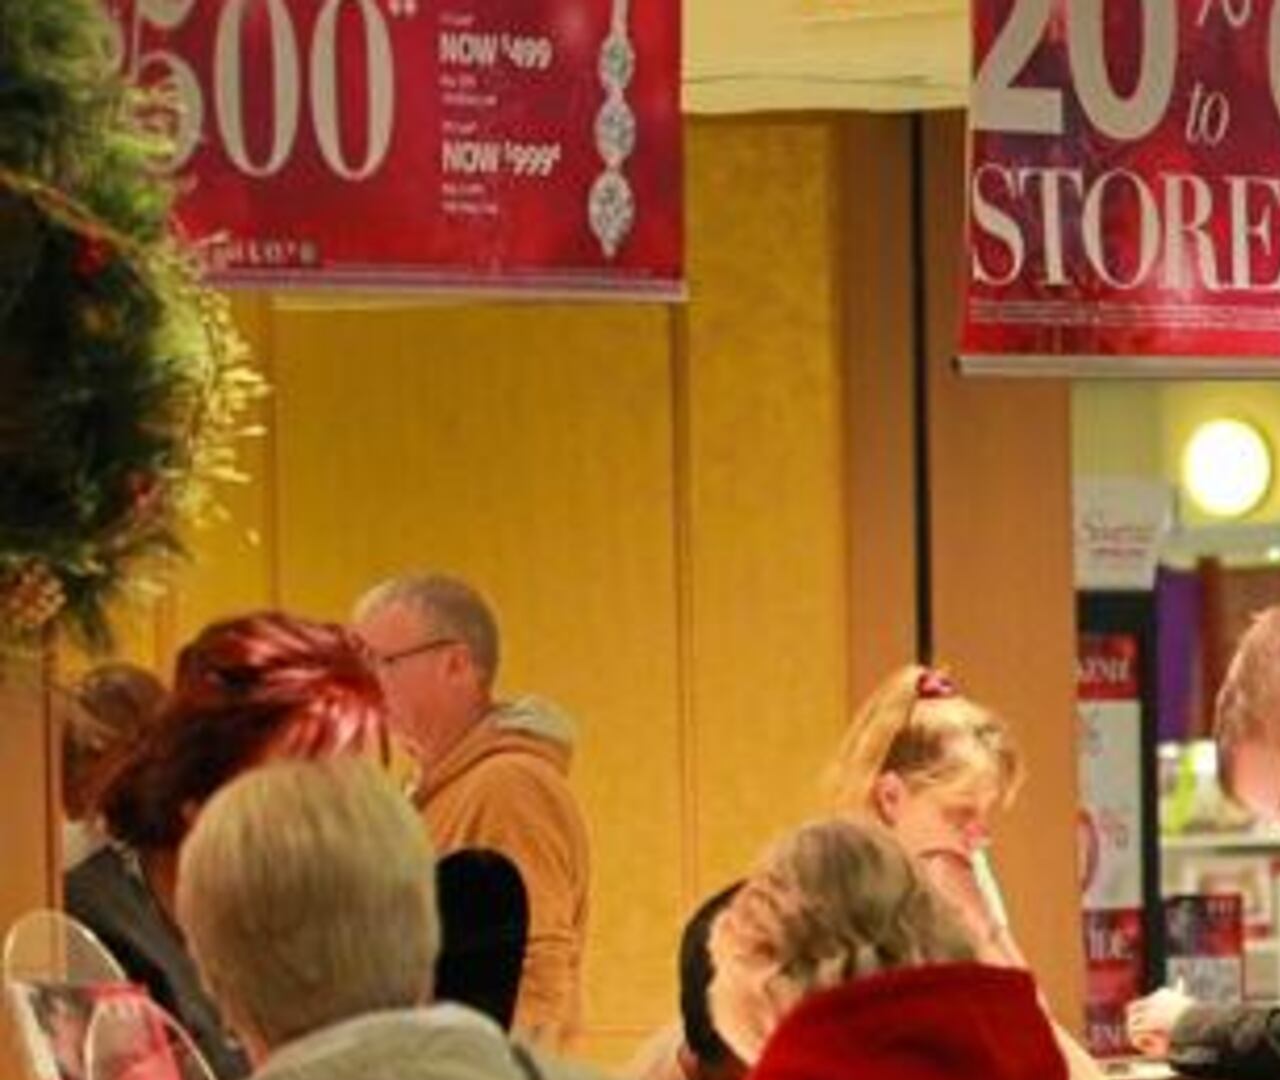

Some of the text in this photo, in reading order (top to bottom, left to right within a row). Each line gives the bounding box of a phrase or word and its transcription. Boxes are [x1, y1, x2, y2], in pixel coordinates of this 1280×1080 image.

[439, 32, 498, 67] NOW
[1186, 83, 1229, 143] to
[441, 142, 500, 175] NOW
